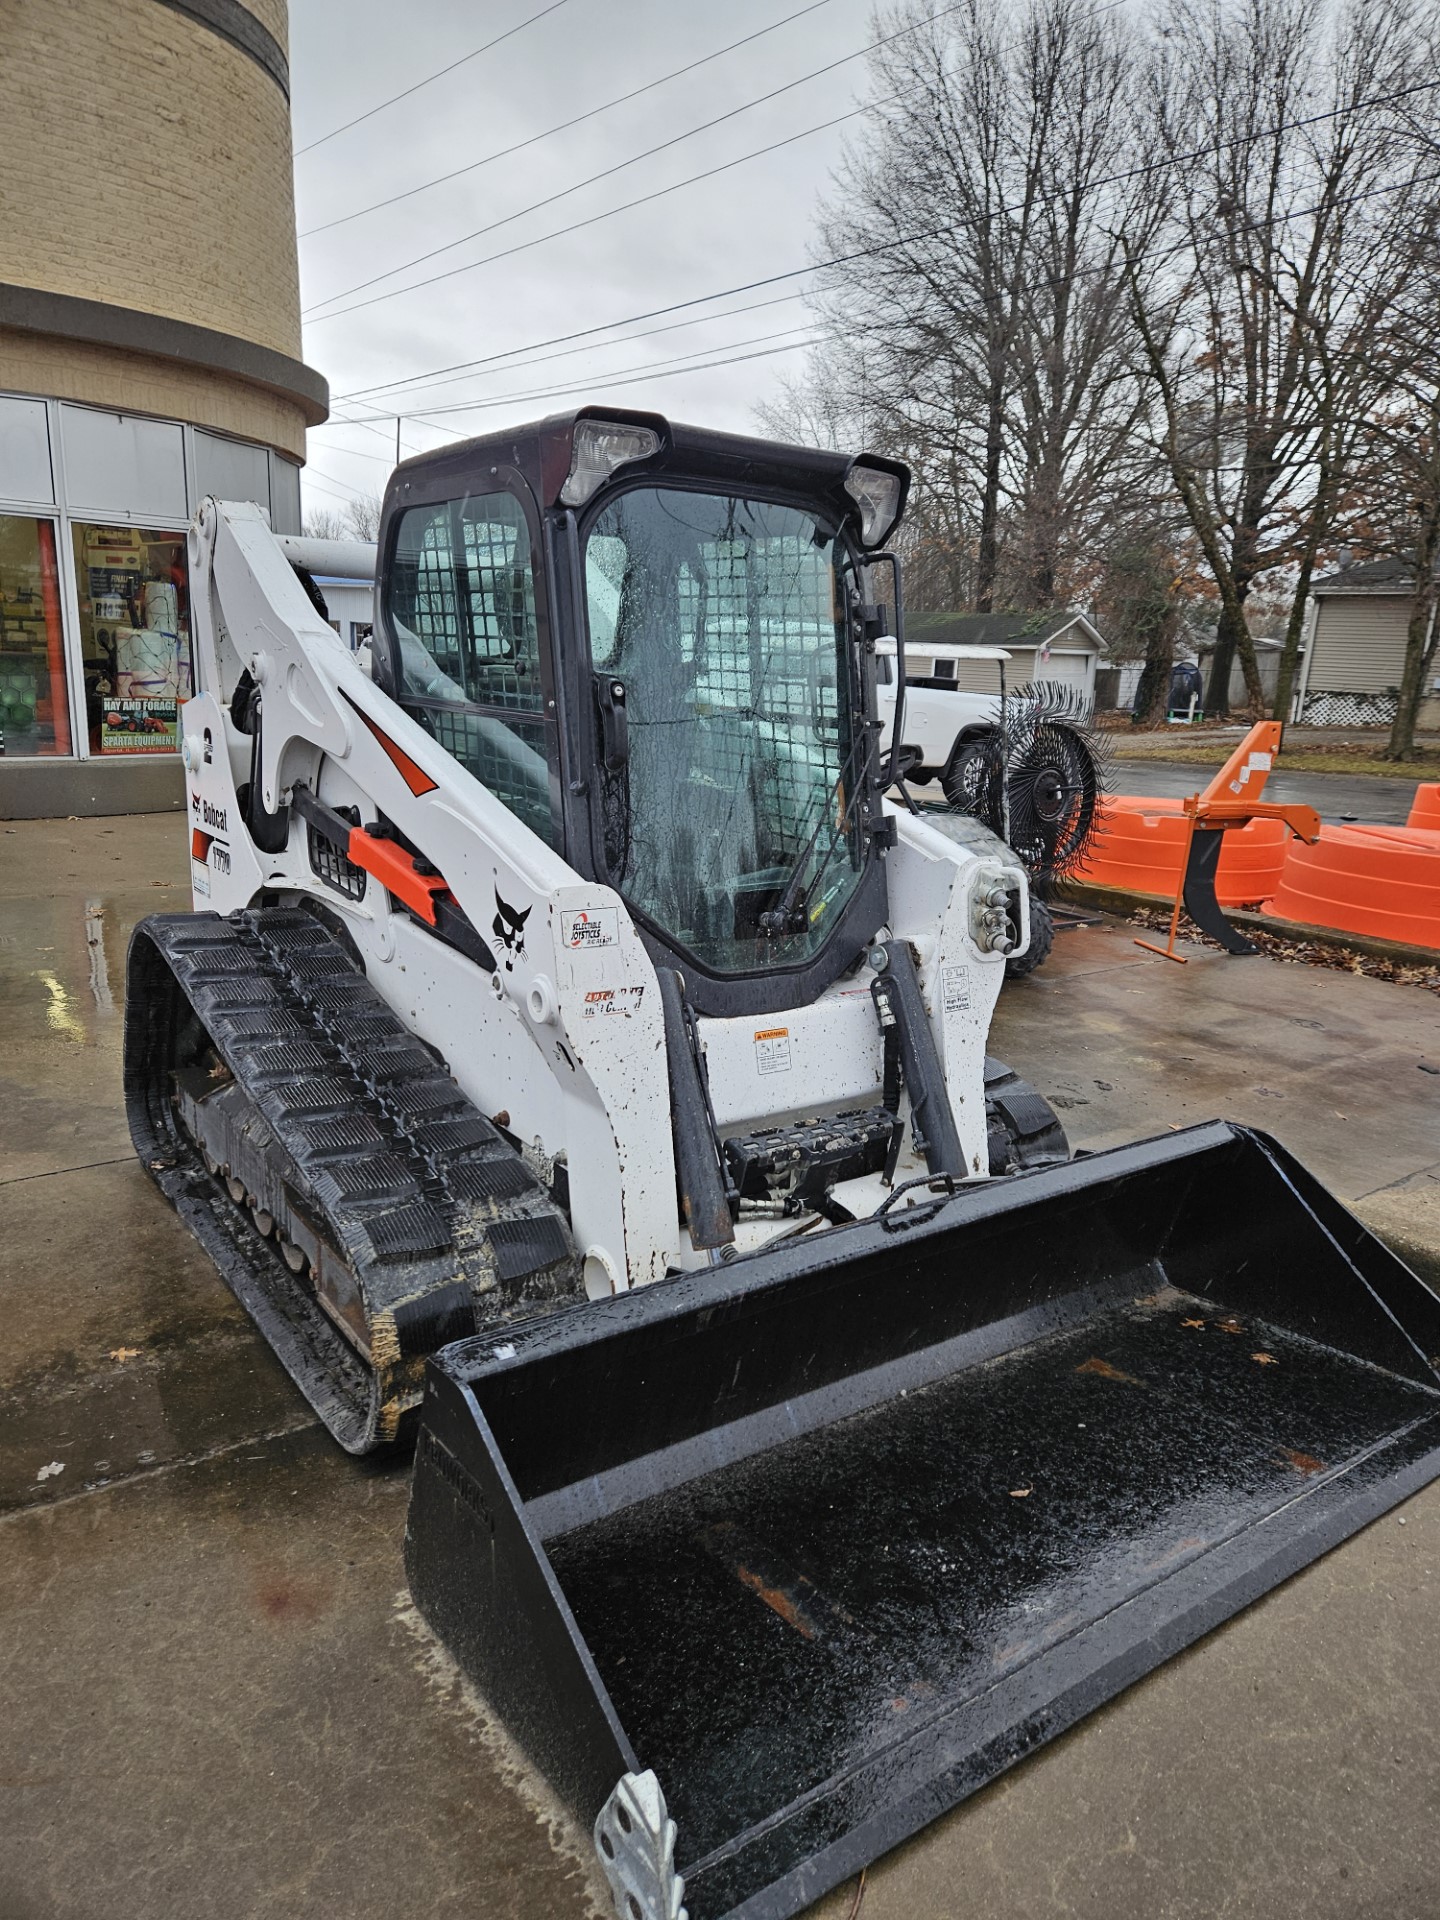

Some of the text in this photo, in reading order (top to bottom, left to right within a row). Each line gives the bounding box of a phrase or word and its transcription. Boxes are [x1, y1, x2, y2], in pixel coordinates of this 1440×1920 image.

[104, 701, 176, 711] HAY AND FORAGE
[103, 736, 176, 747] SPARTA EQUIPMENT
[203, 799, 228, 832] Bobcat
[572, 921, 602, 931] SELECTABLE
[571, 929, 601, 940] JOYSTICKS
[762, 1030, 786, 1038] WARNING
